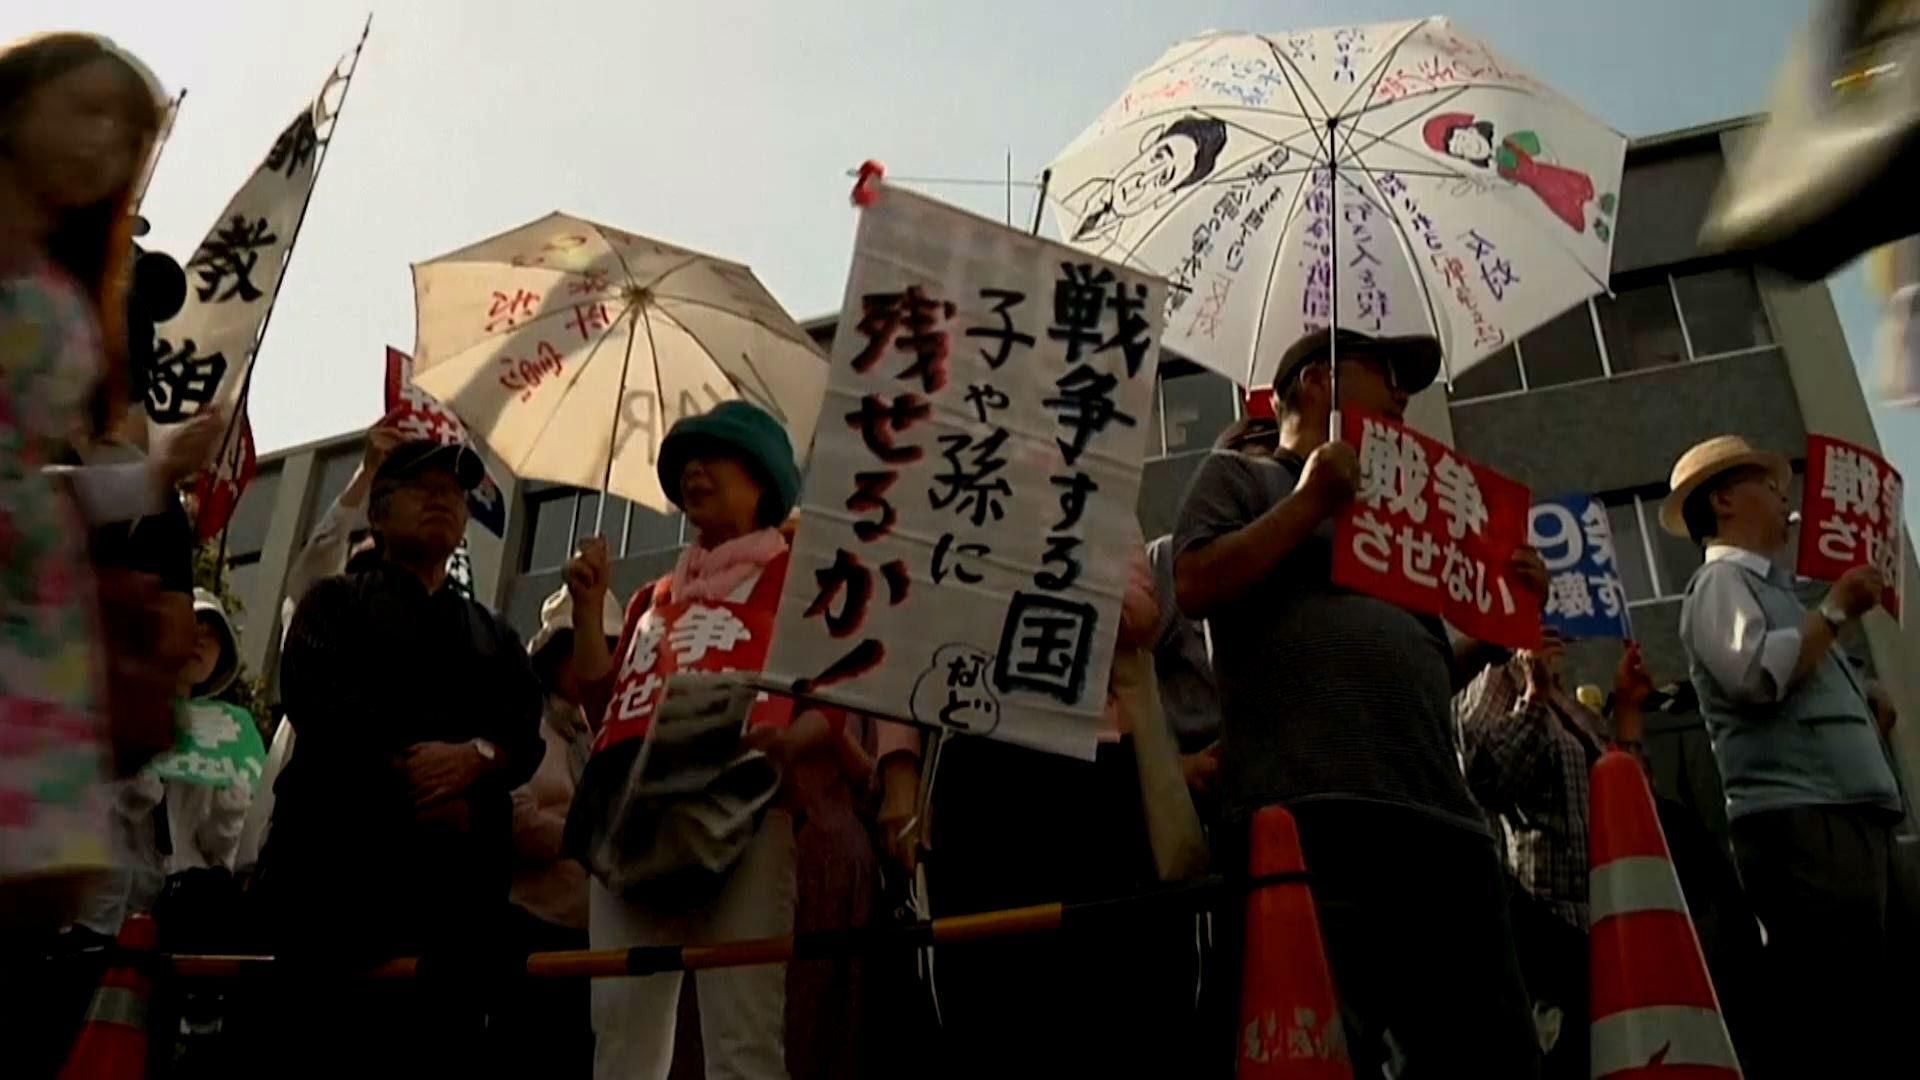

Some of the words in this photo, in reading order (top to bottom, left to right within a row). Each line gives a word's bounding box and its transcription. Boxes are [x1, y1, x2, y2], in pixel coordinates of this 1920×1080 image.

[928, 288, 1036, 586] 子や孫に
[994, 261, 1152, 704] 戦争する国
[1357, 417, 1489, 538] 戦争
[1352, 510, 1516, 615] させない
[939, 655, 993, 731] など
